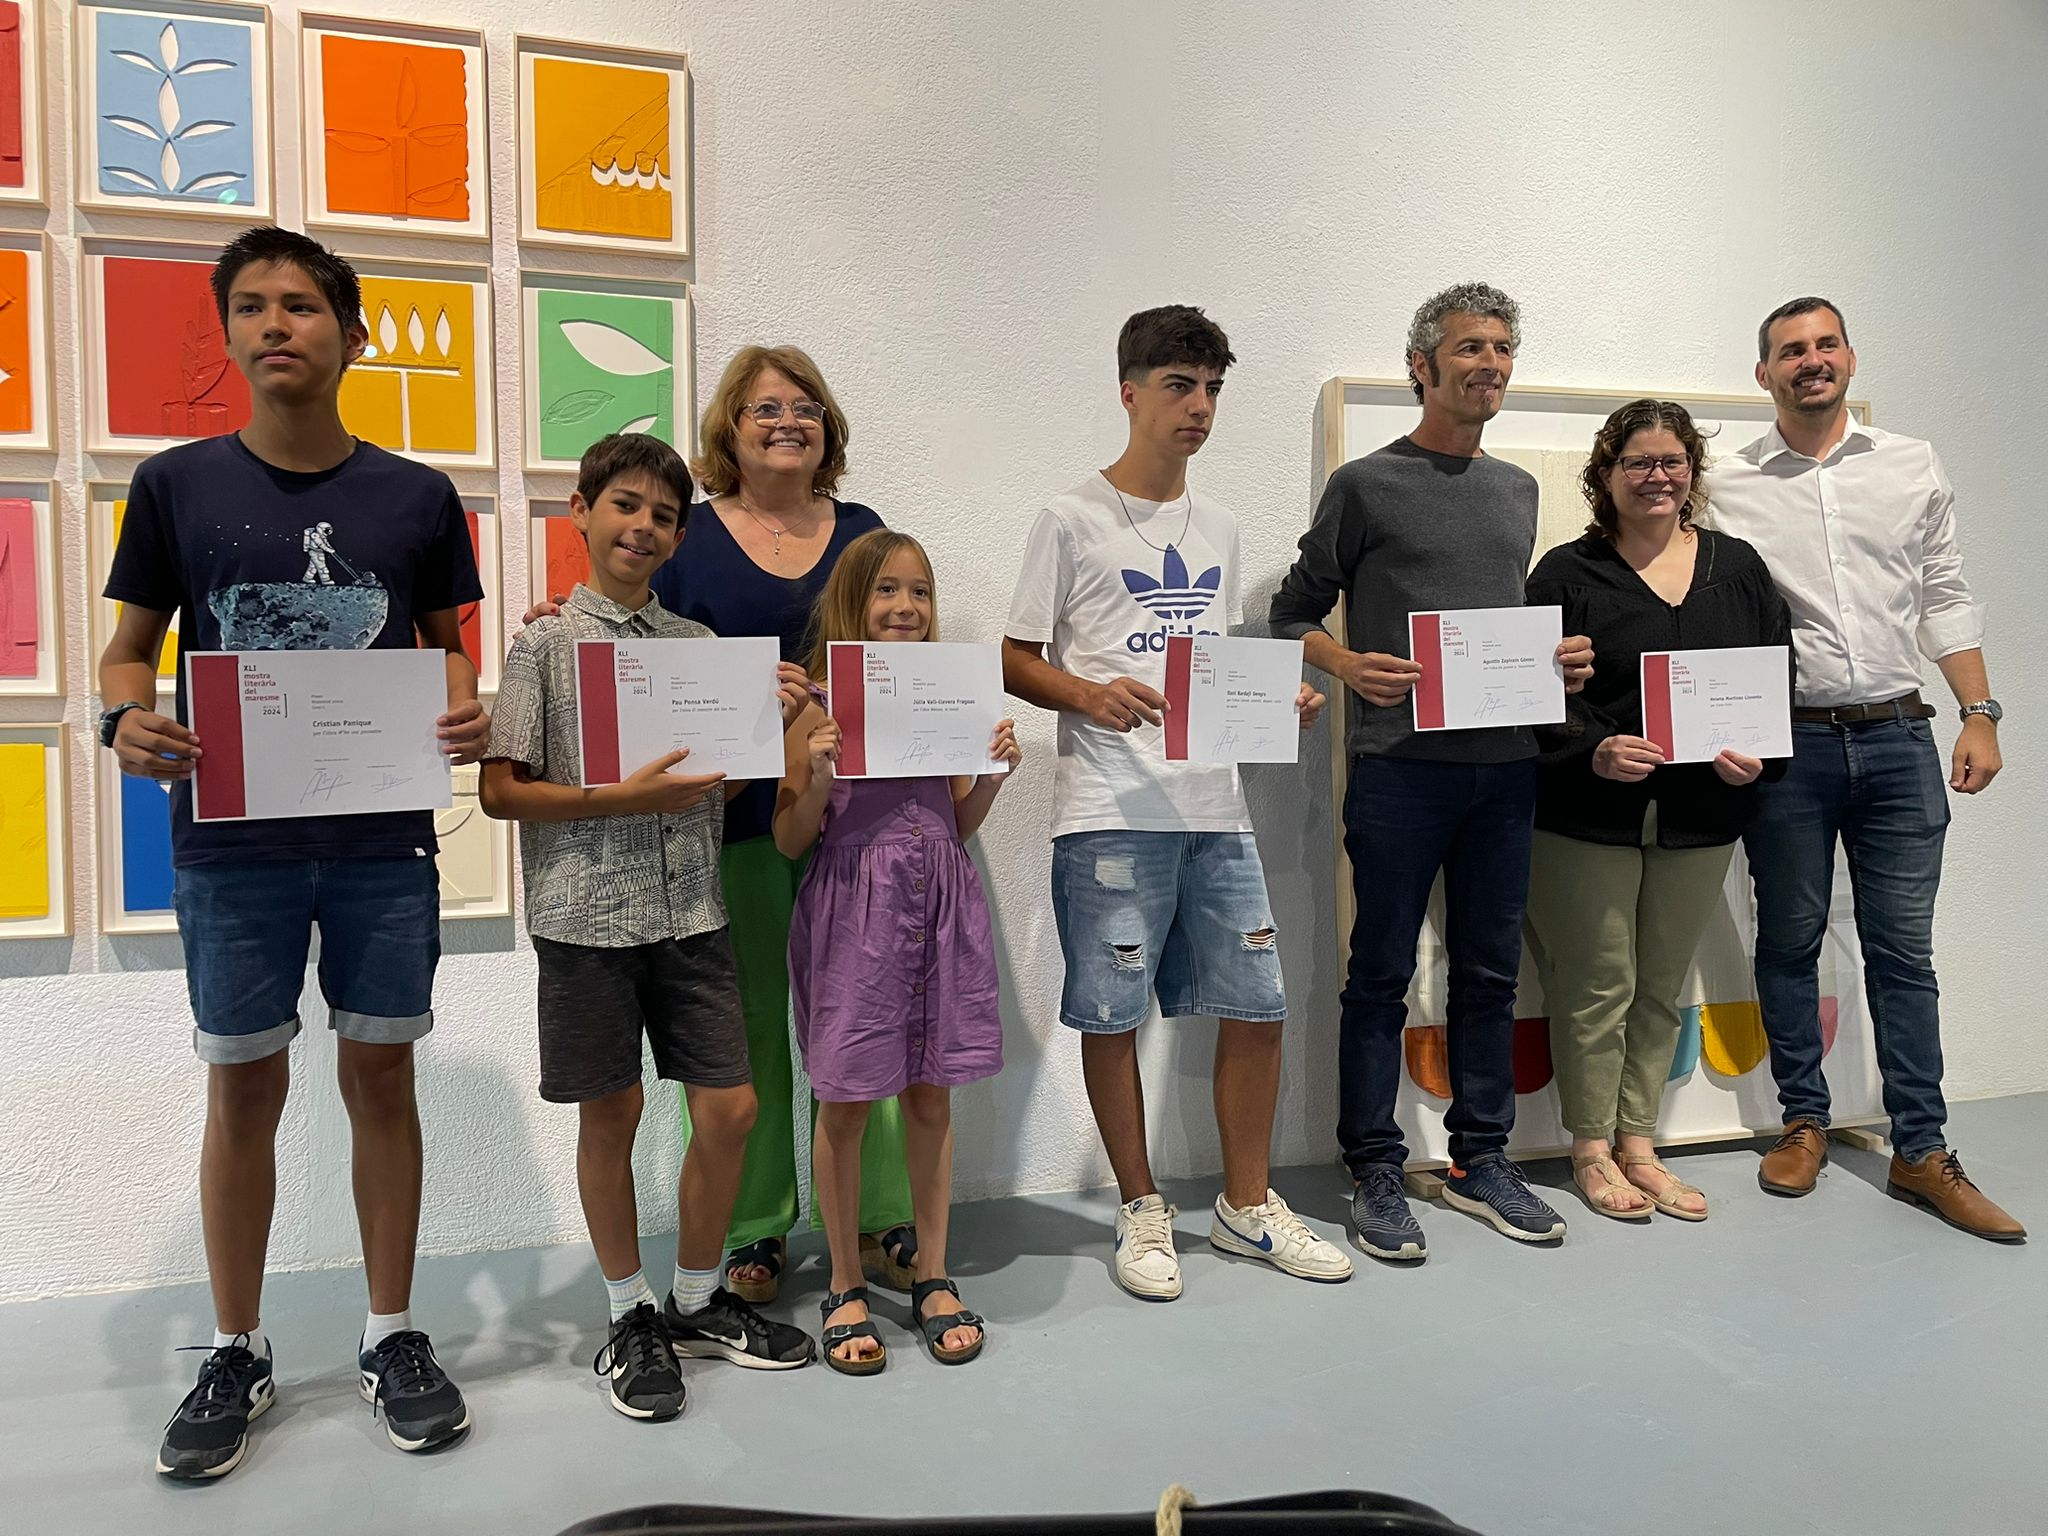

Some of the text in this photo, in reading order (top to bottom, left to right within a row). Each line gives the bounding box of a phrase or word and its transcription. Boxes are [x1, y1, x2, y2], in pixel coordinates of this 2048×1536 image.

[243, 672, 271, 680] mostra
[262, 708, 281, 716] 2024
[312, 719, 372, 728] Cristian Panique
